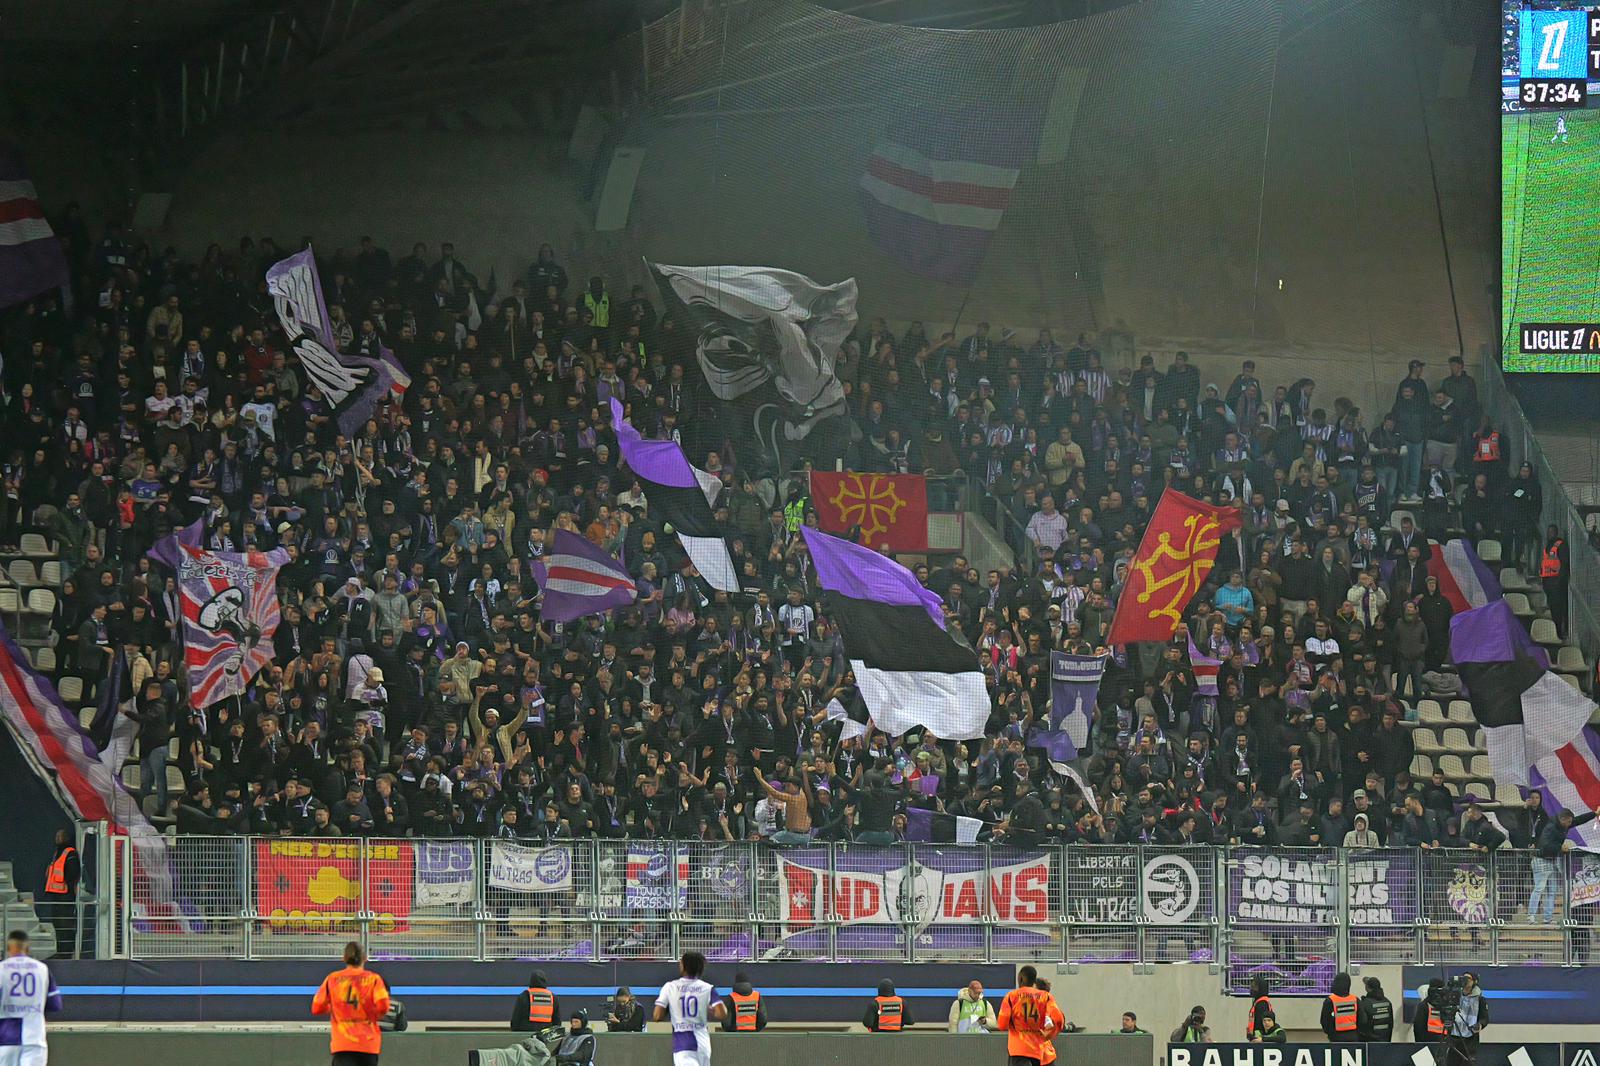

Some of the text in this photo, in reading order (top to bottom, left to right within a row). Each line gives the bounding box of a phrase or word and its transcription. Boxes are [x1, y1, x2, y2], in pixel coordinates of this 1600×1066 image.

[1523, 83, 1581, 103] 37:34
[1524, 330, 1570, 350] LIGUE
[270, 840, 314, 858] FIER
[1078, 854, 1137, 869] LIBERTAT
[492, 864, 533, 885] ULTRAS
[701, 866, 724, 880] BT
[1092, 876, 1124, 889] PELS
[575, 892, 623, 907] ADIEN
[1240, 877, 1291, 903] LOS
[627, 895, 687, 909] PRESENS
[1075, 896, 1137, 922] ULTRAS
[1237, 901, 1312, 923] GANHAN
[9, 971, 36, 997] 20
[346, 983, 359, 1010] 4
[678, 995, 699, 1018] 10
[1021, 1001, 1039, 1024] 14
[1170, 1048, 1363, 1066] BAHRAIN
